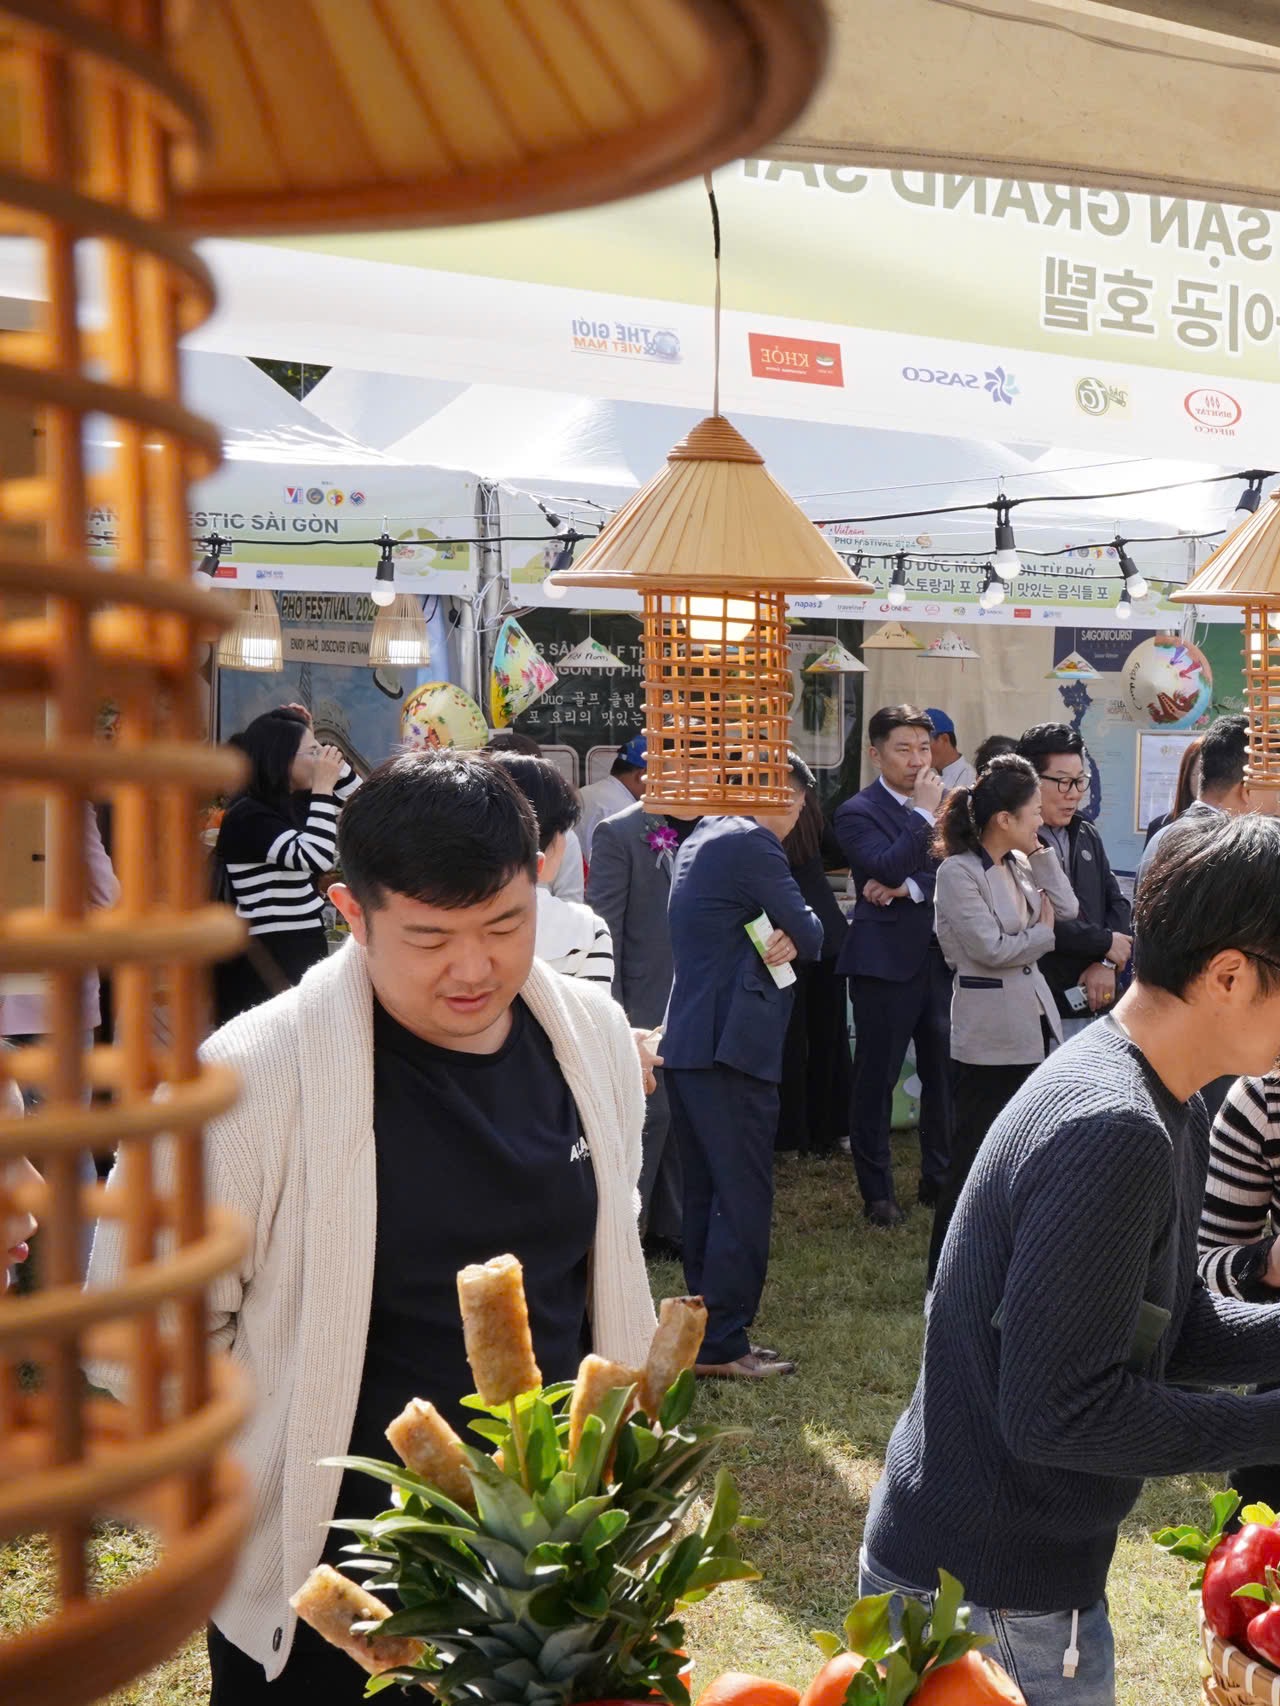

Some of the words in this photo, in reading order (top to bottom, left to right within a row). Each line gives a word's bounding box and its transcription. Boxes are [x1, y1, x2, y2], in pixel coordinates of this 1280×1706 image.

[251, 511, 286, 532] SÀI
[292, 513, 339, 534] GÒN
[1017, 583, 1054, 598] 맛있는
[1057, 584, 1093, 600] 음식들
[304, 595, 354, 621] FESTIVAL
[572, 691, 600, 707] 골프
[549, 710, 591, 725] 요리의
[601, 711, 644, 726] 맛있는
